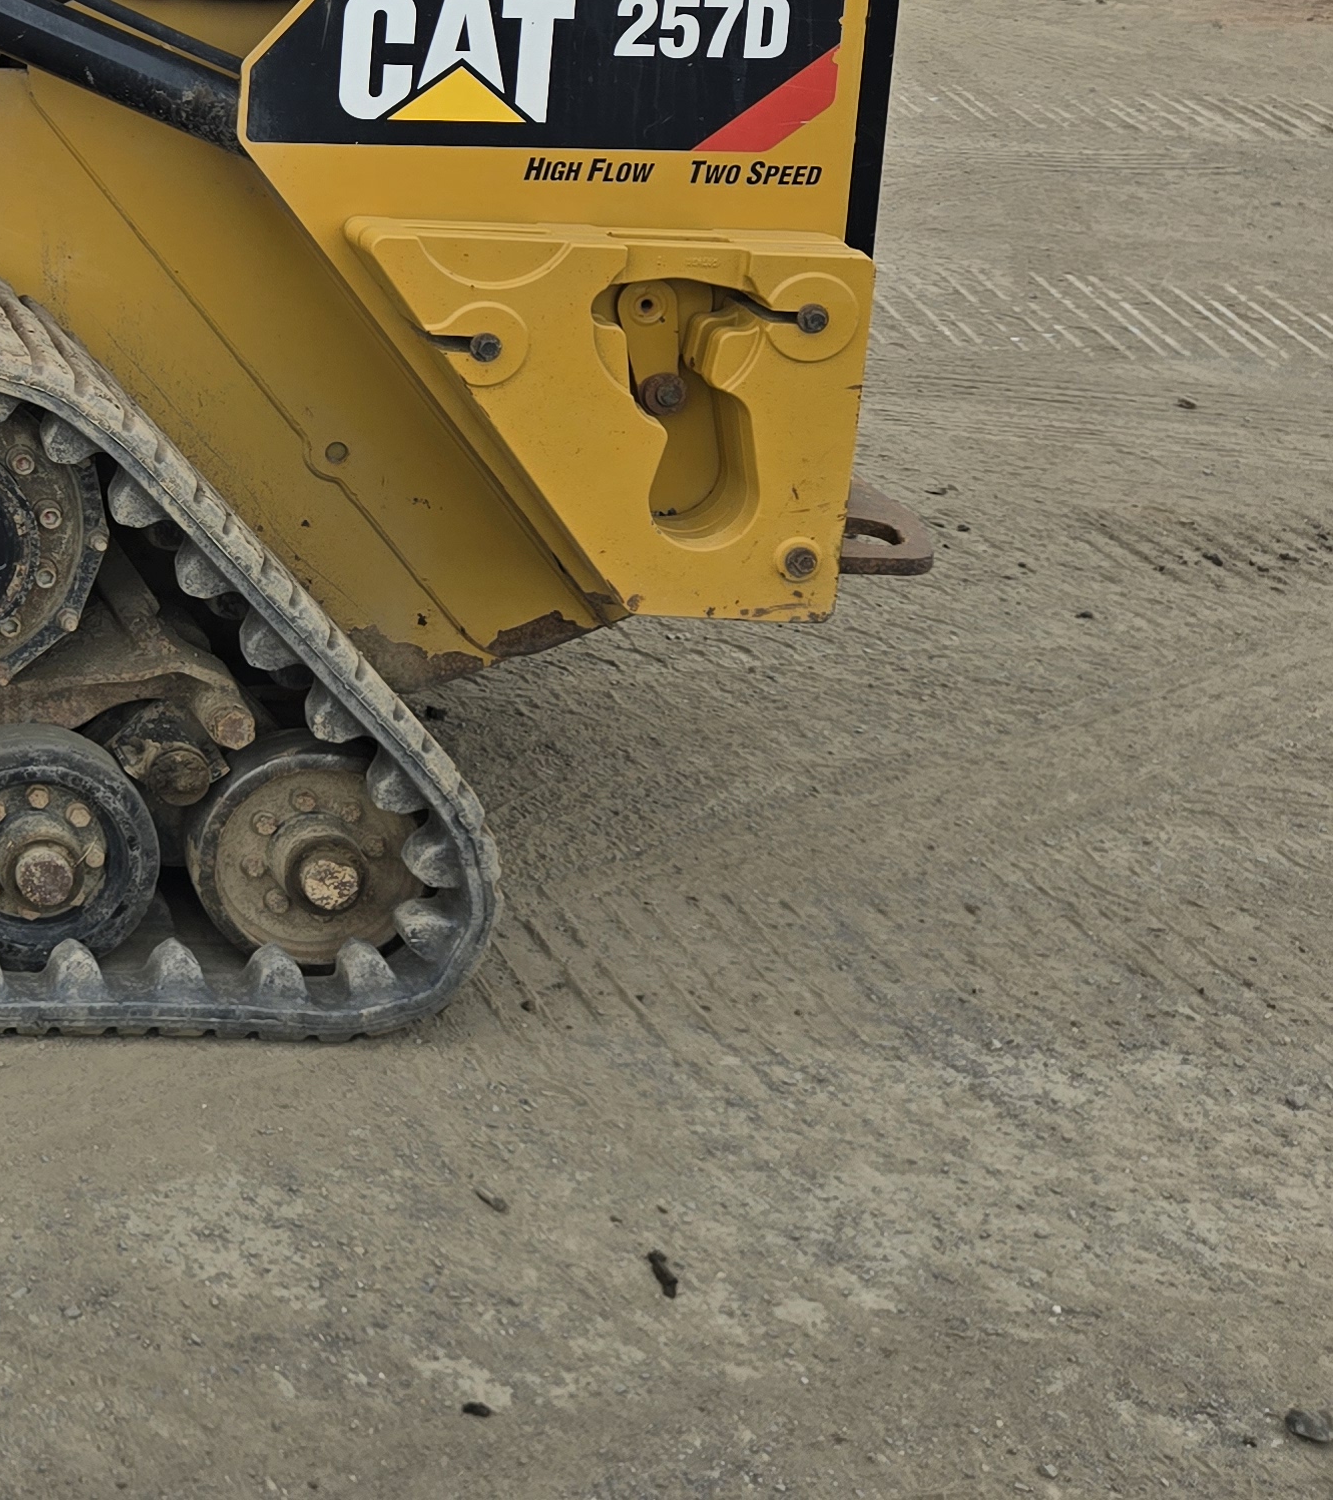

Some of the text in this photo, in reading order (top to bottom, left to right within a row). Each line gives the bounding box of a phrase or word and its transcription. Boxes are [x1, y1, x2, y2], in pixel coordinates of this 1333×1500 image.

[523, 157, 823, 186] HIGH FLOW TWO SPEED
